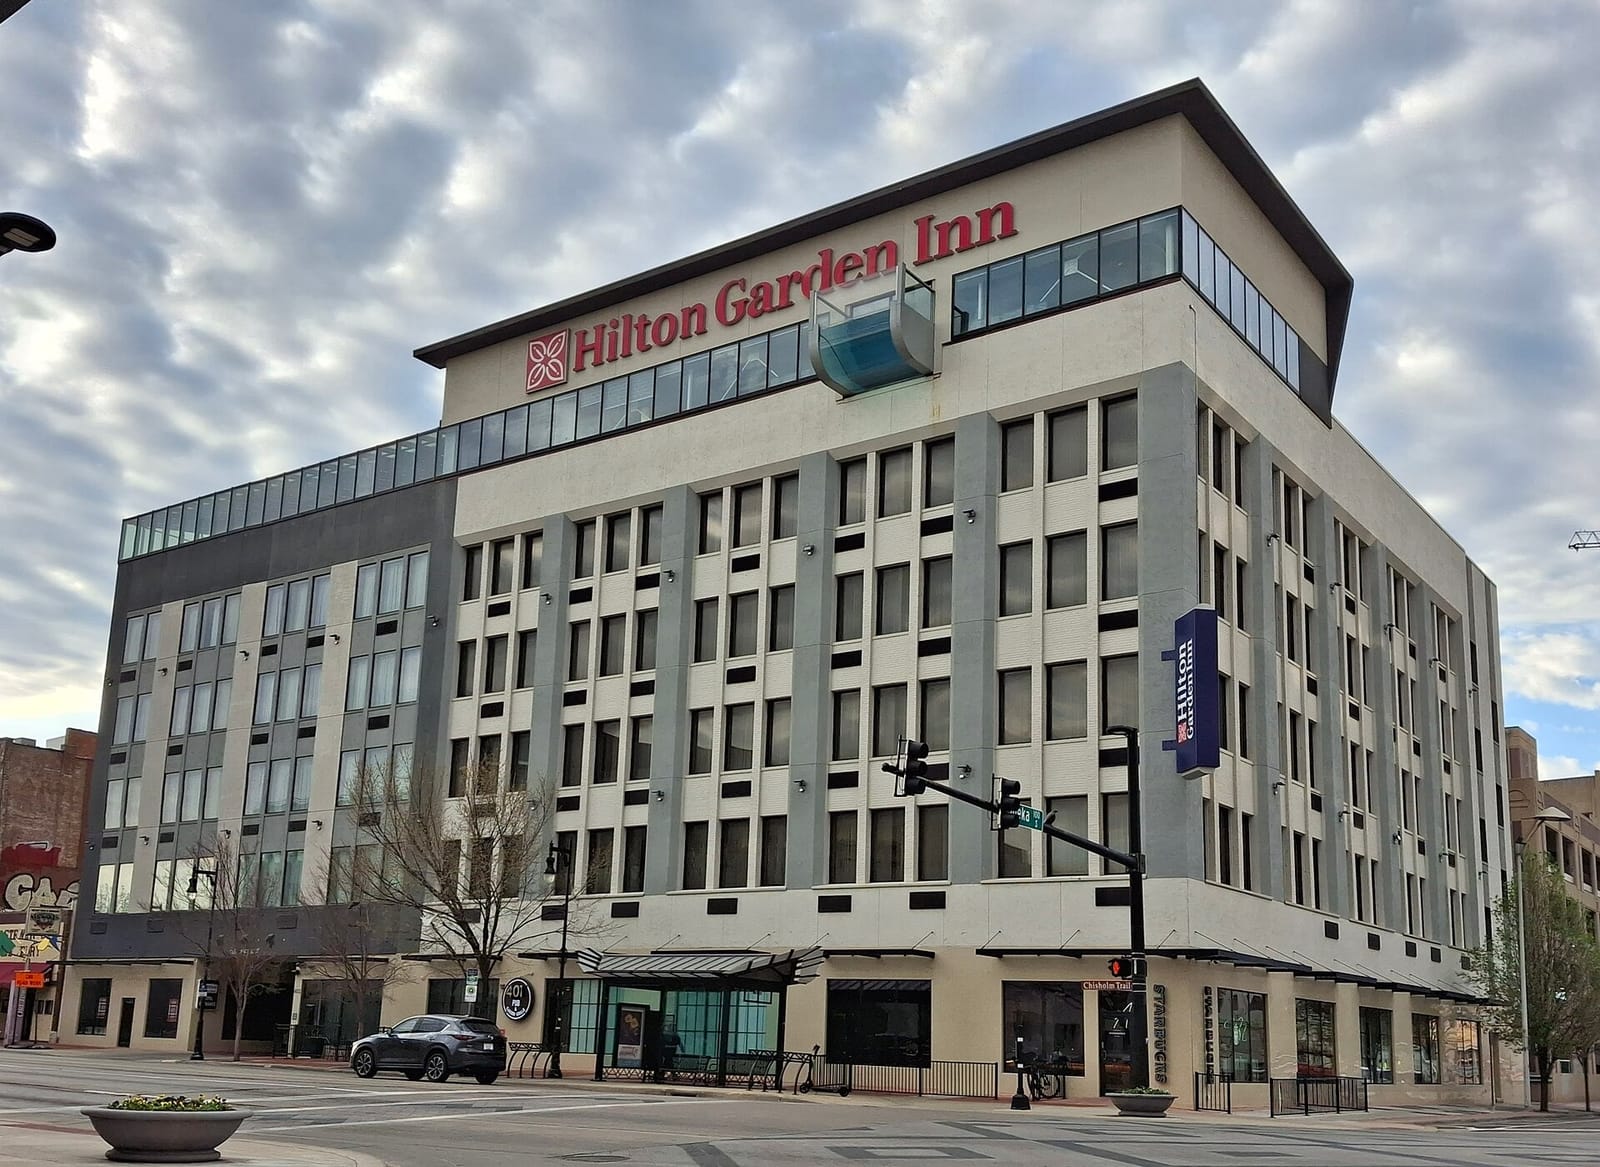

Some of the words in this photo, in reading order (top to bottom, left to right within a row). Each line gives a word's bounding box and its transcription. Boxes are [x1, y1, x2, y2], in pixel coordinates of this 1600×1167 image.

[573, 301, 708, 373] Hilton
[714, 238, 900, 327] Garden
[912, 200, 1019, 266] Inn
[1177, 641, 1187, 723] Hilton
[1186, 670, 1194, 740] Garden
[506, 984, 523, 998] 401
[1083, 981, 1115, 989] Chisholm
[1115, 981, 1131, 989] Trail
[1153, 984, 1167, 1083] STARBUCKS
